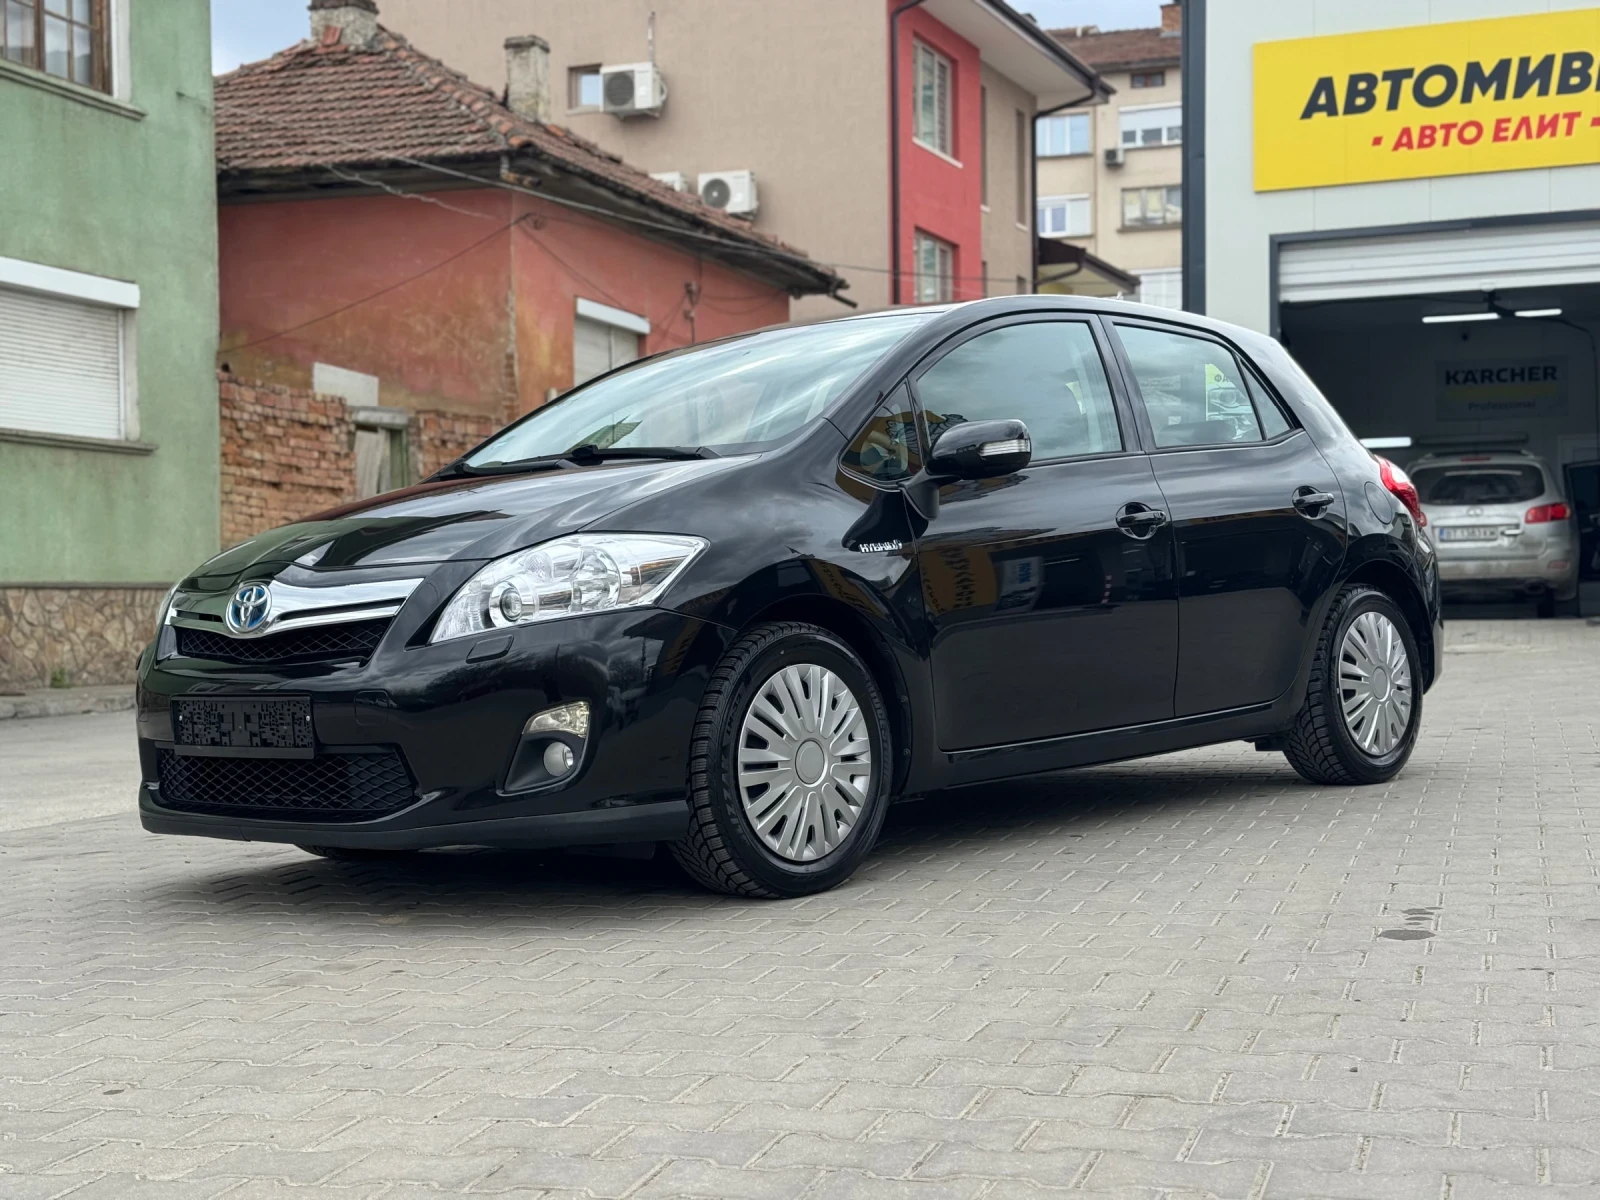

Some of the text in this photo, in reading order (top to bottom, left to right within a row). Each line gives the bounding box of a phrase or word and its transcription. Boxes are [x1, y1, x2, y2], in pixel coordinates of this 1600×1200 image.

[1300, 51, 1600, 120] АВТОМИВ
[1392, 111, 1582, 151] АВТО ЕЛИТ
